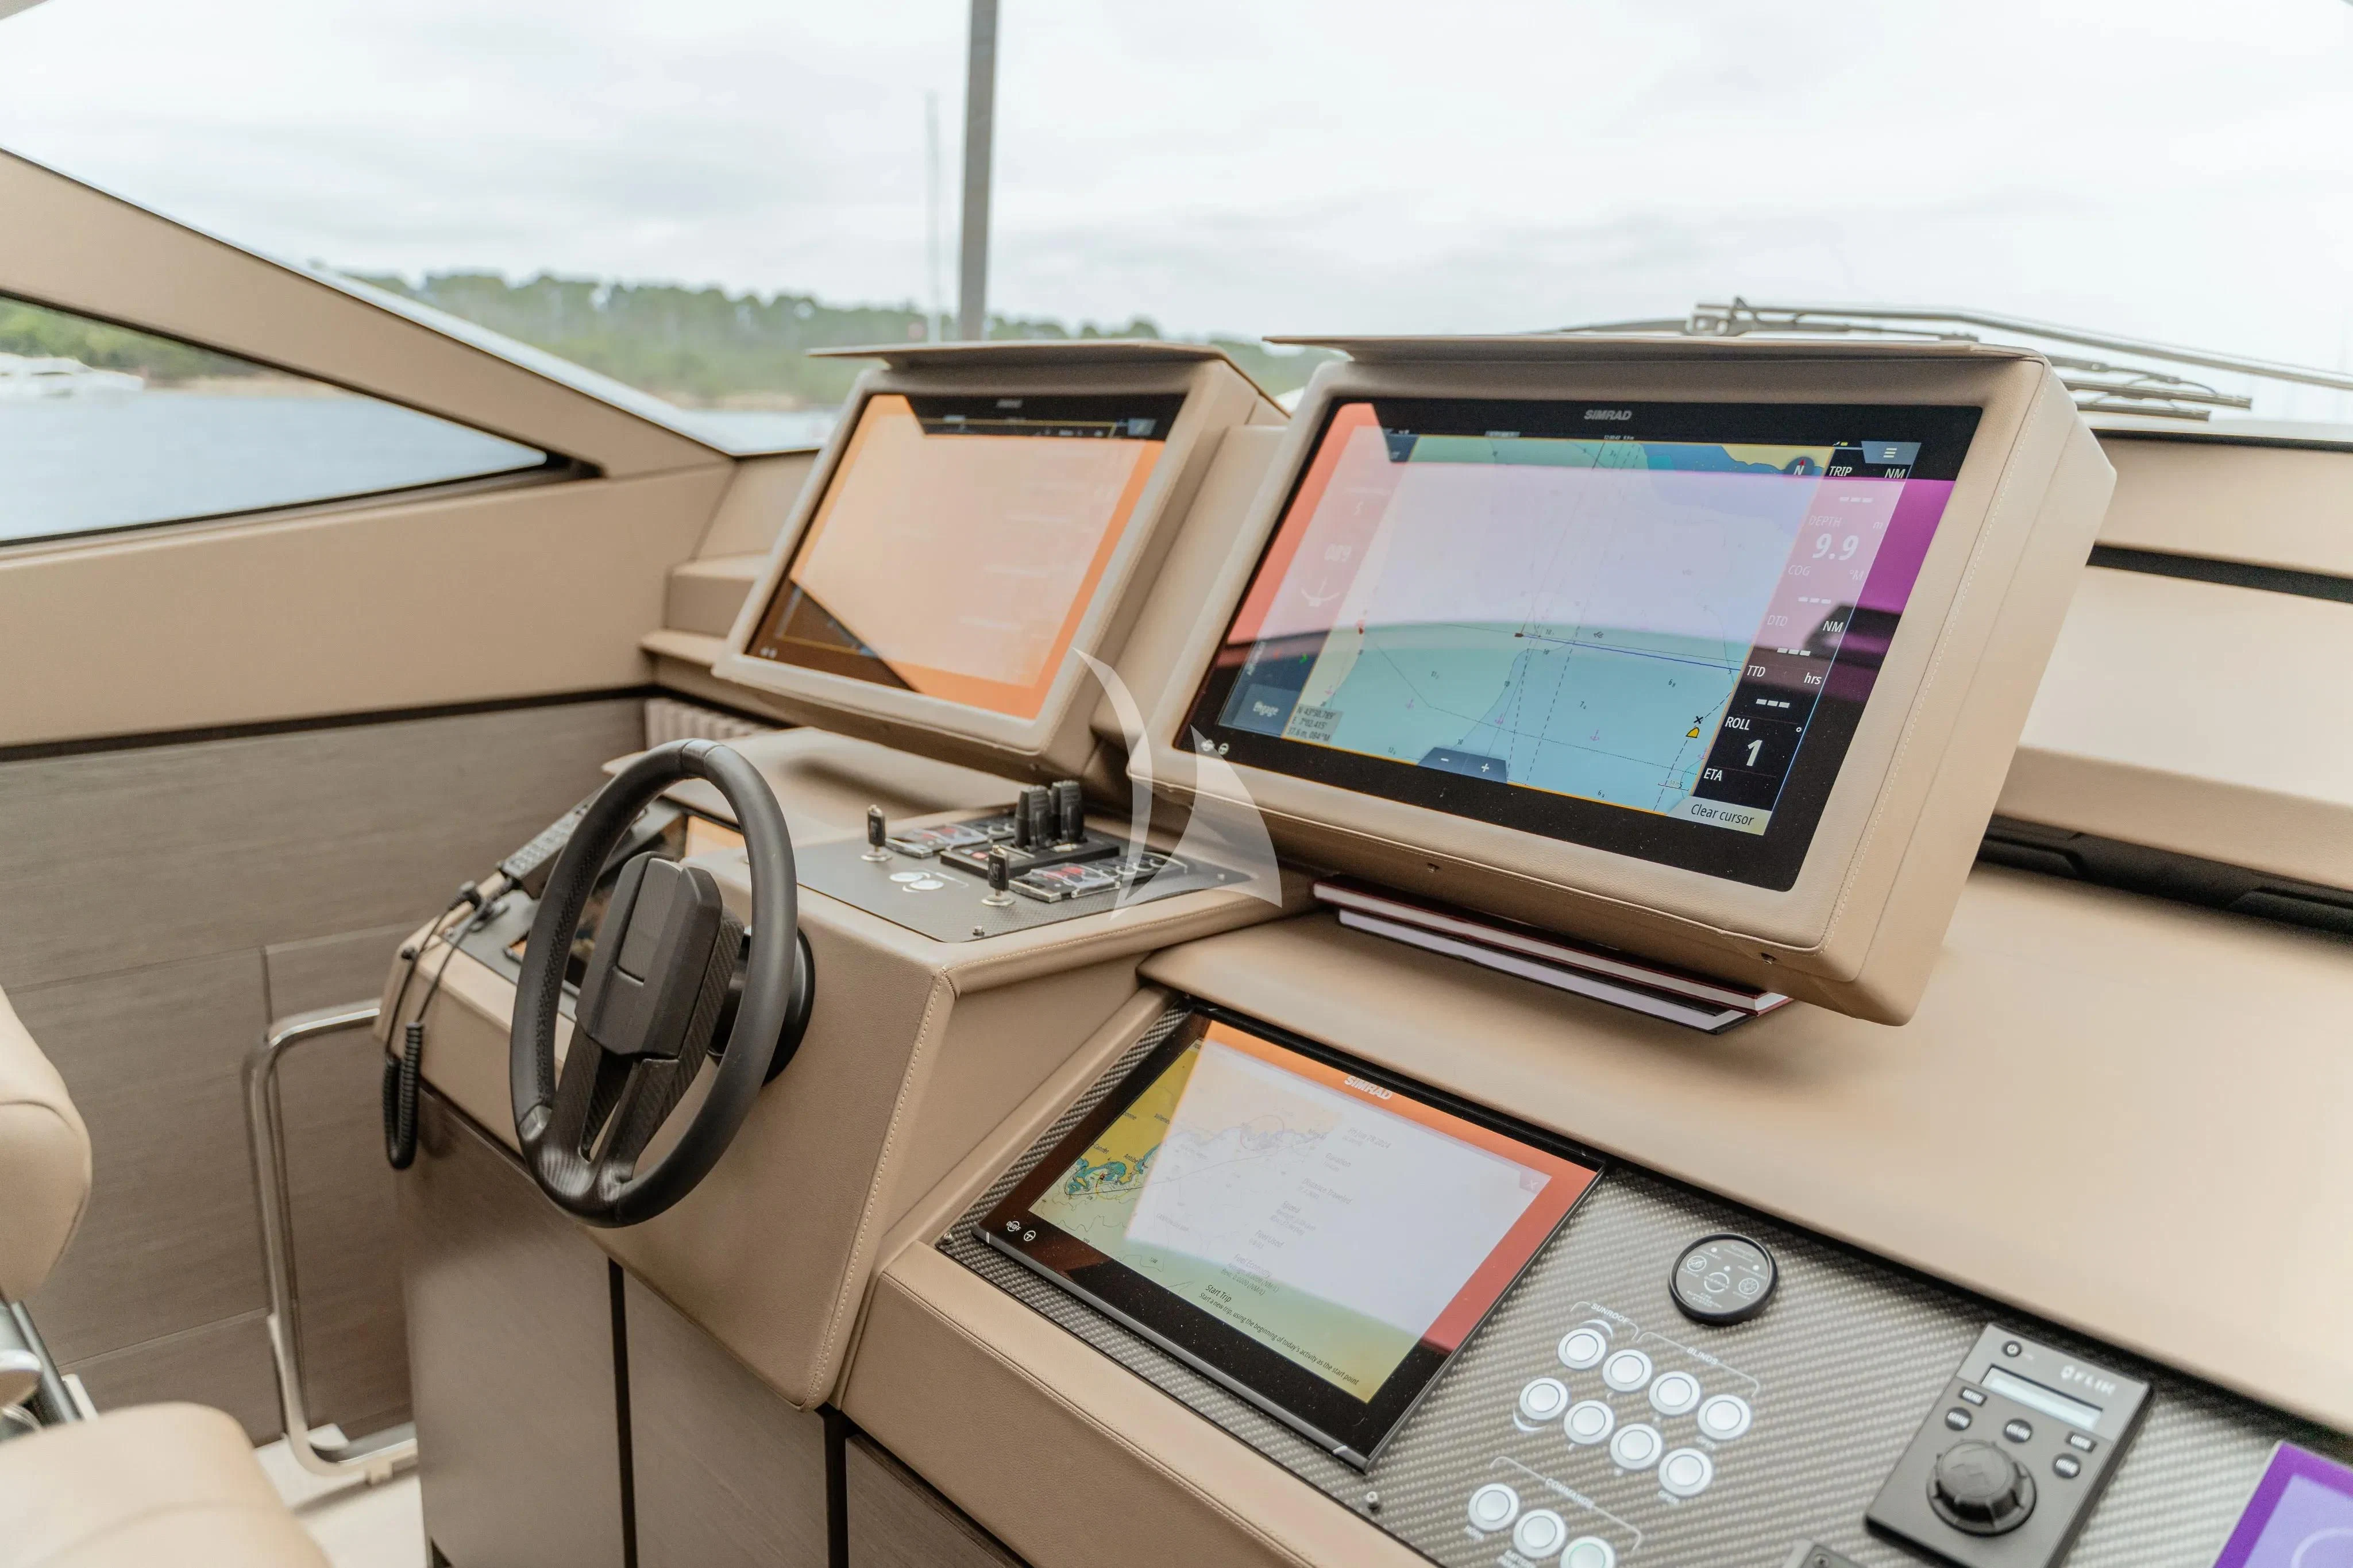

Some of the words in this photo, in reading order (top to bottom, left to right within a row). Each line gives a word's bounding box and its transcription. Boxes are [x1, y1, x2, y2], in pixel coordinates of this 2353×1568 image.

[1584, 410, 1632, 420] SIMRAD
[1829, 466, 1853, 477] TRIP
[1884, 468, 1905, 479] NM
[1810, 515, 1843, 527] DEPTH
[1812, 533, 1859, 561] 9.9
[1788, 565, 1811, 577] COG
[1767, 615, 1788, 627] DTD
[1822, 620, 1844, 632] NM
[1746, 665, 1766, 677] TTD
[1803, 672, 1822, 685] hrs
[1725, 716, 1750, 731] ROLL
[1746, 740, 1762, 766] 1
[1703, 768, 1723, 781] ETA
[1691, 804, 1718, 819] Clear
[1719, 810, 1754, 826] cursor
[1344, 1075, 1393, 1099] SIMRAD
[1206, 1284, 1221, 1296] Start
[1220, 1291, 1232, 1303] Trip
[1591, 1302, 1630, 1324] SUNROOF
[1199, 1292, 1212, 1303] Start
[1213, 1301, 1224, 1310] new
[1222, 1306, 1232, 1315] trip,
[1233, 1312, 1247, 1323] using
[1245, 1318, 1255, 1327] the
[1253, 1323, 1278, 1341] beginning
[1282, 1339, 1301, 1353] today's
[1299, 1349, 1318, 1362] activity
[1322, 1362, 1333, 1371] the
[1332, 1367, 1345, 1378] start
[1342, 1374, 1359, 1385] point
[1687, 1346, 1718, 1366] BLINDS
[1962, 1389, 1983, 1404] MENU
[1546, 1478, 1593, 1509] COMMANDS
